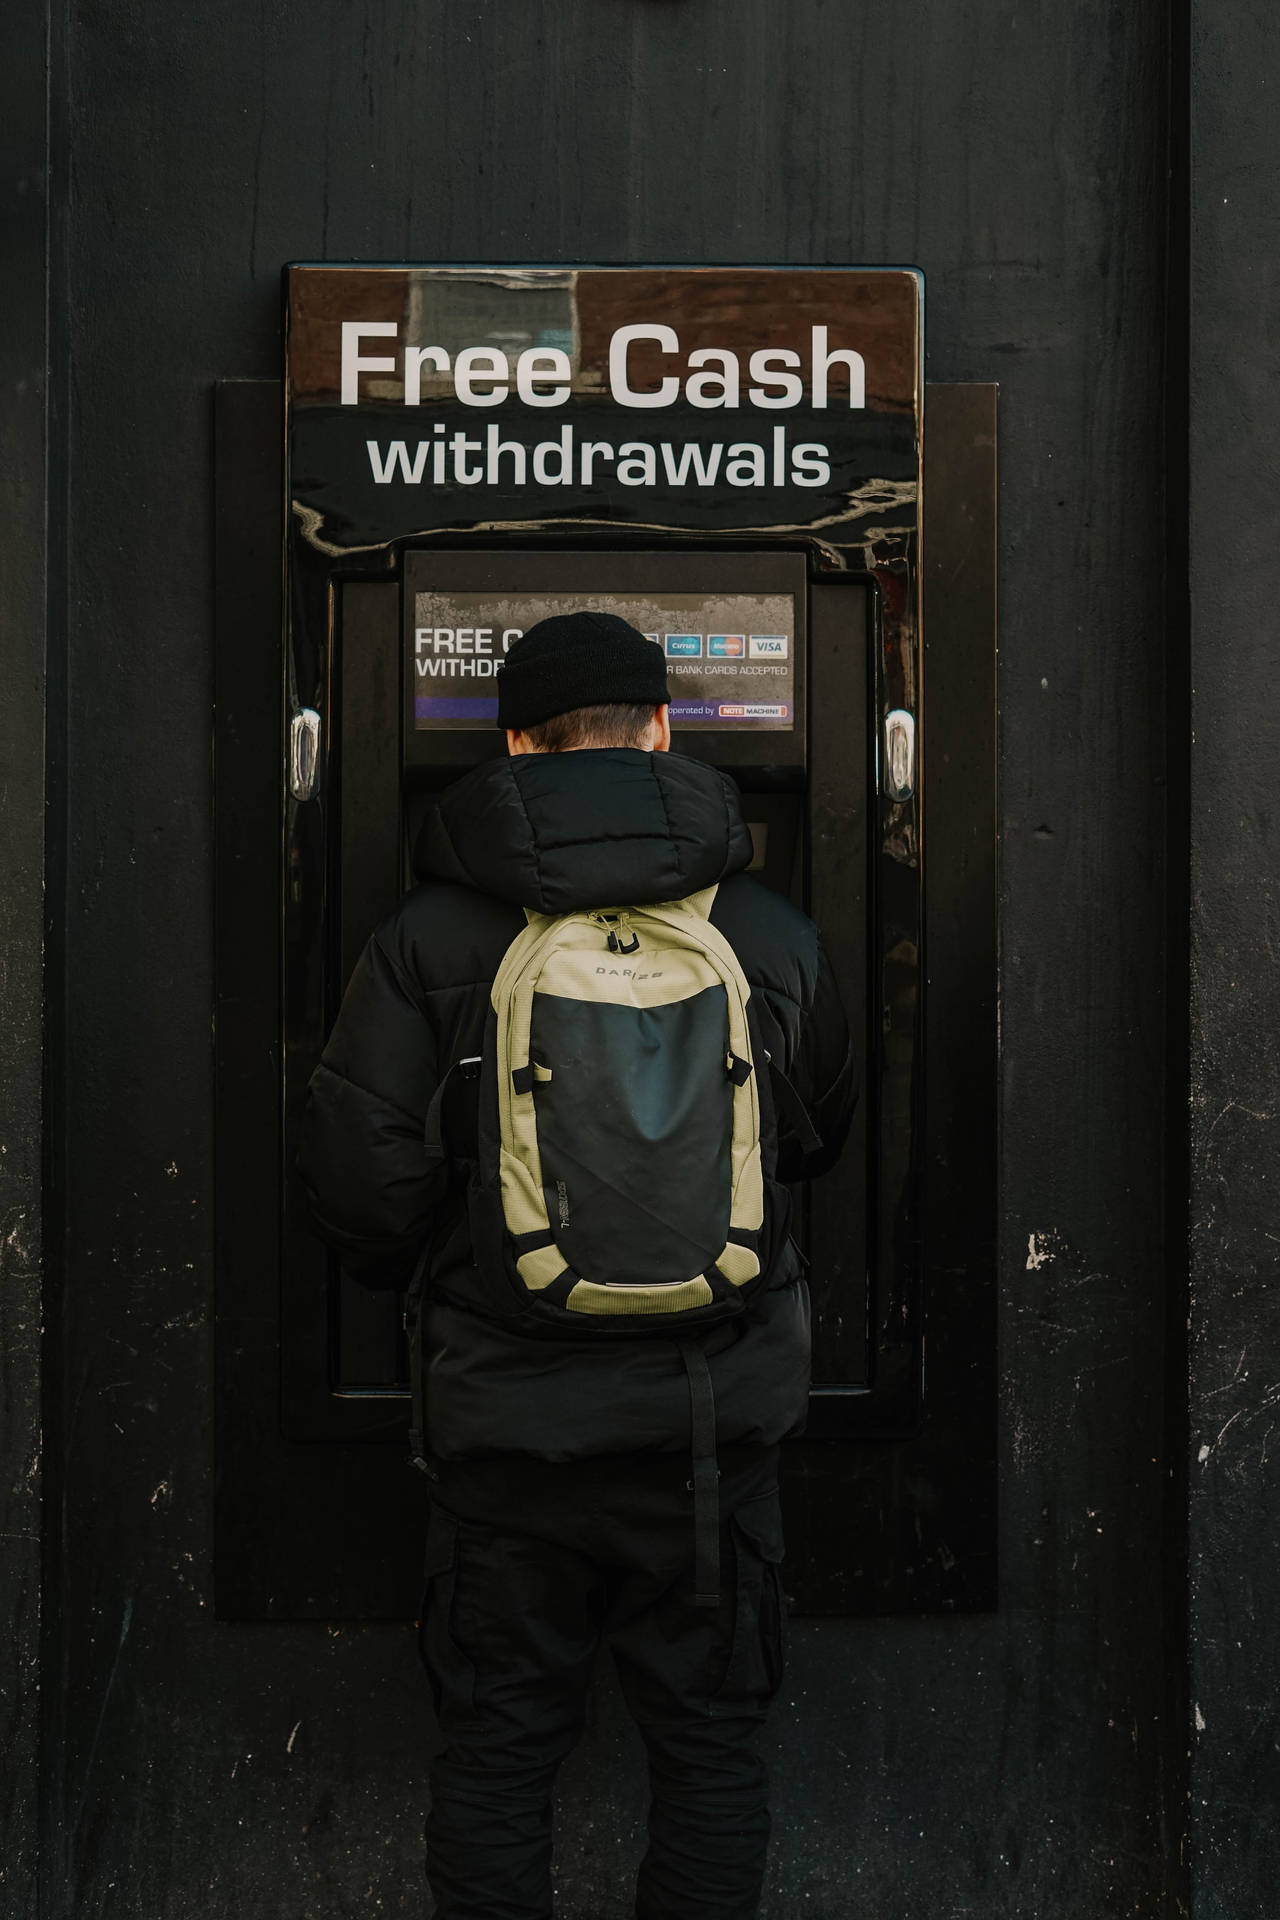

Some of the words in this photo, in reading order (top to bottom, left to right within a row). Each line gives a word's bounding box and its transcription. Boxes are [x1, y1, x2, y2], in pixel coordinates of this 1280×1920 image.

[340, 321, 572, 408] Free
[608, 323, 866, 410] Cash
[366, 423, 832, 487] withdrawals
[415, 628, 493, 654] FREE
[757, 642, 782, 652] VISA
[675, 665, 702, 675] BANK
[704, 665, 738, 675] CARDS
[739, 665, 788, 676] ACCEPTED
[668, 706, 703, 716] operated
[704, 706, 715, 716] by
[746, 707, 780, 715] MACHINE
